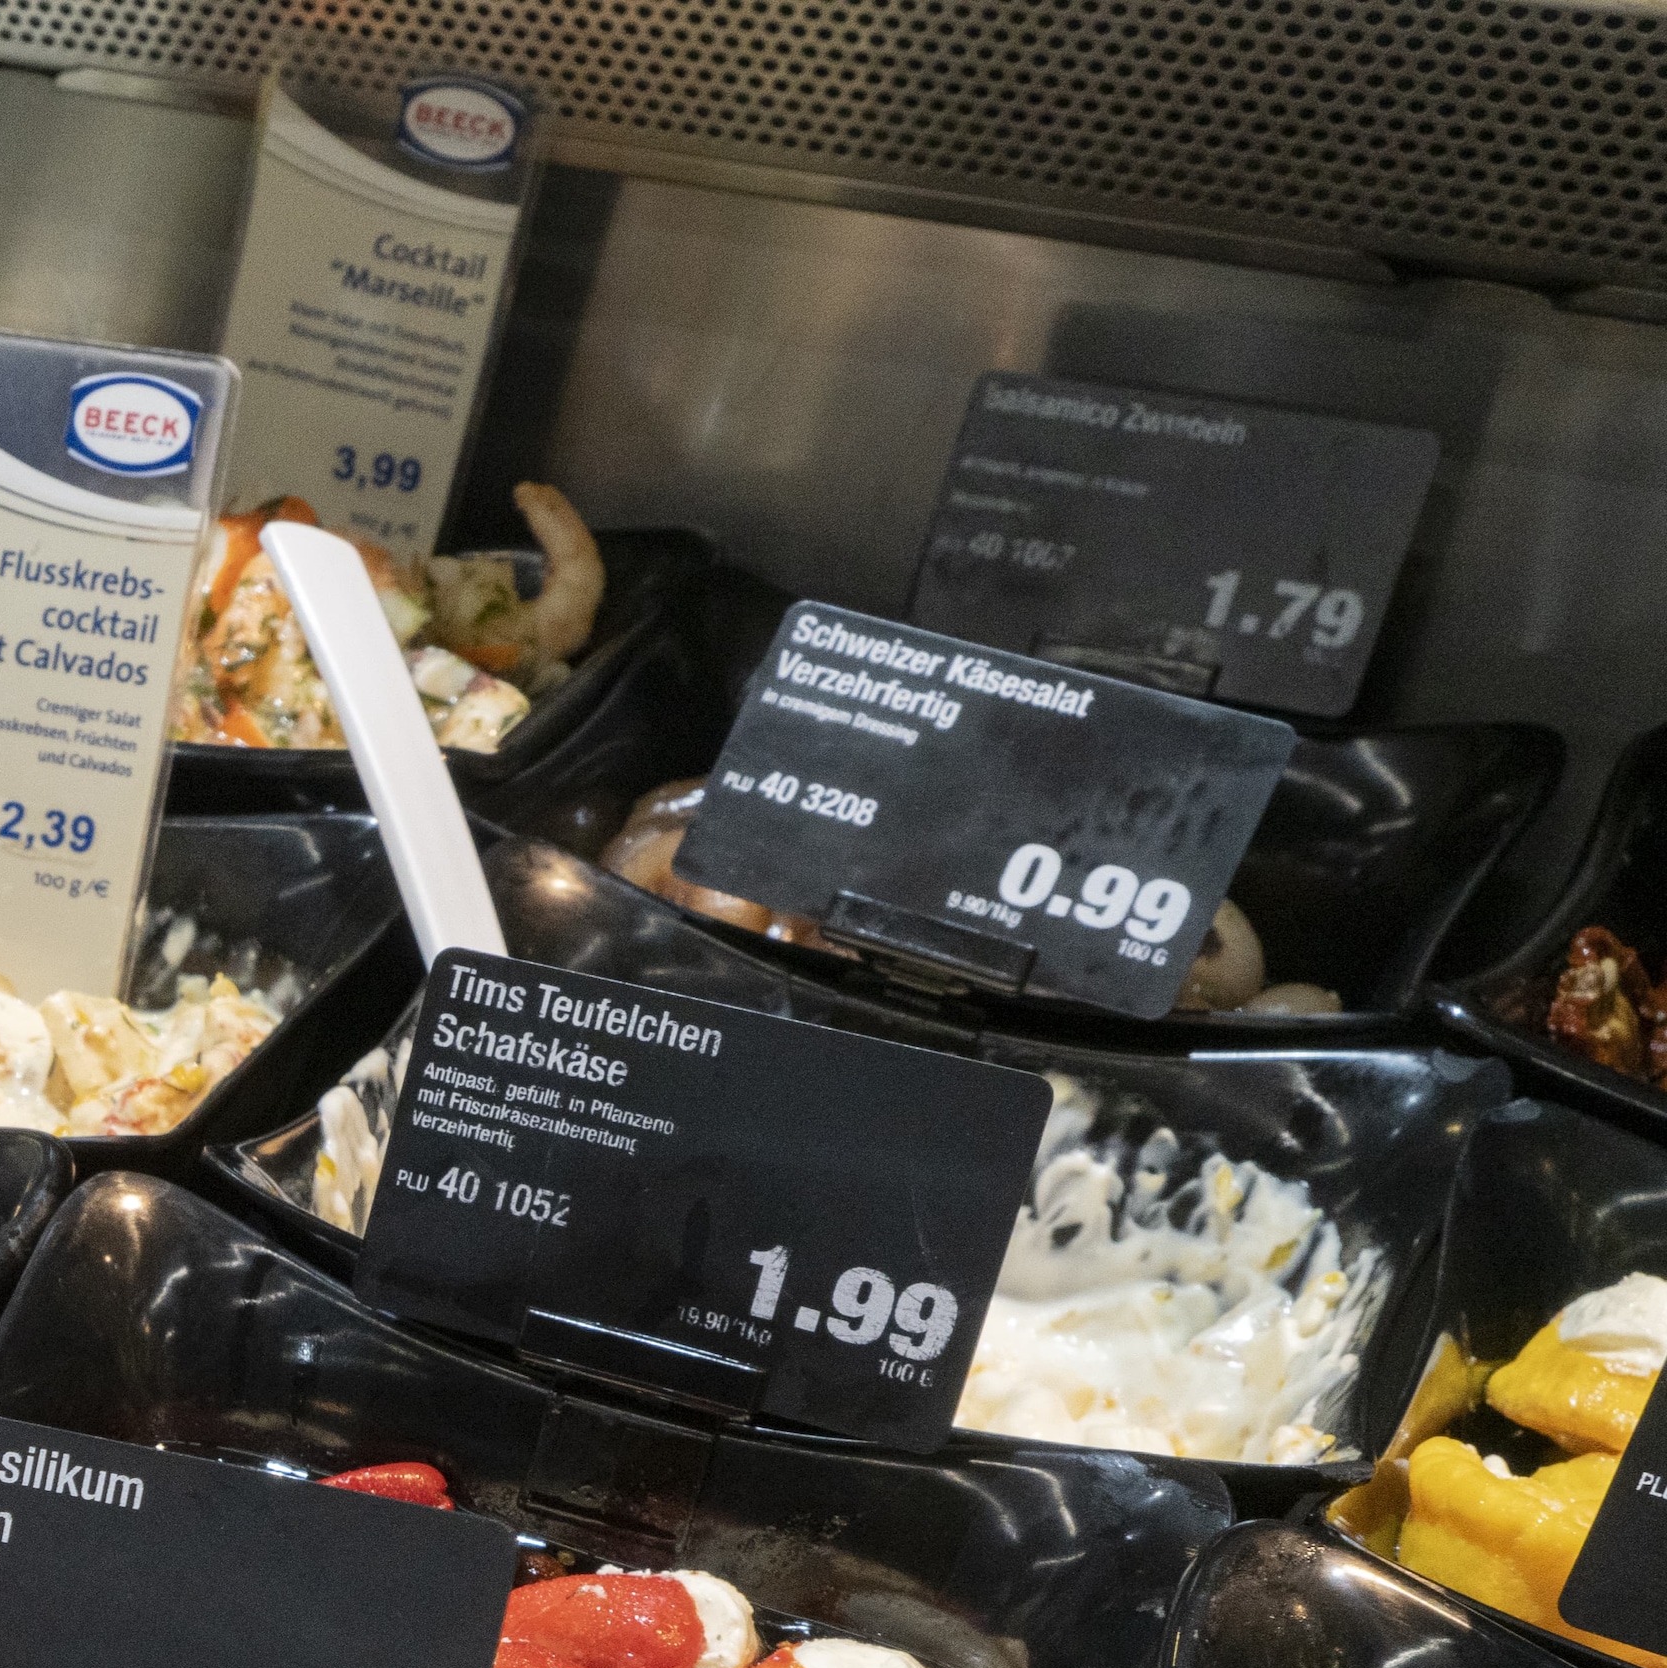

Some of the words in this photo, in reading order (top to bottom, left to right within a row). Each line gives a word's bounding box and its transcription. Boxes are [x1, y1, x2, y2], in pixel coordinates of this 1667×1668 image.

[415, 102, 506, 140] BEECK
[372, 232, 487, 280] Cocktail
[84, 406, 178, 439] BEECK
[333, 445, 422, 493] 3,99
[42, 603, 158, 644] cocktail
[1205, 568, 1364, 648] 1.79
[13, 639, 149, 687] Calvados
[791, 614, 946, 677] Schweizer
[945, 655, 1095, 719] Käsesalat
[37, 698, 101, 723] Cremiger
[106, 709, 141, 728] Salat
[776, 649, 963, 730] Verzehrfertig
[69, 753, 132, 777] Calvados
[74, 730, 137, 752] Früchten
[758, 770, 799, 804] 40
[800, 784, 879, 827] 3208
[998, 842, 1192, 943] 0.99
[449, 963, 526, 1014] Tims
[537, 982, 722, 1057] Teufelchen
[432, 1012, 628, 1087] Schafskäse
[413, 1108, 517, 1153] Verzehrfertig
[449, 1092, 637, 1156] Frischkäsezubereitung
[396, 1169, 429, 1193] PLU
[437, 1166, 481, 1203] 40
[495, 1180, 572, 1227] 1052
[749, 1244, 958, 1361] 1.99
